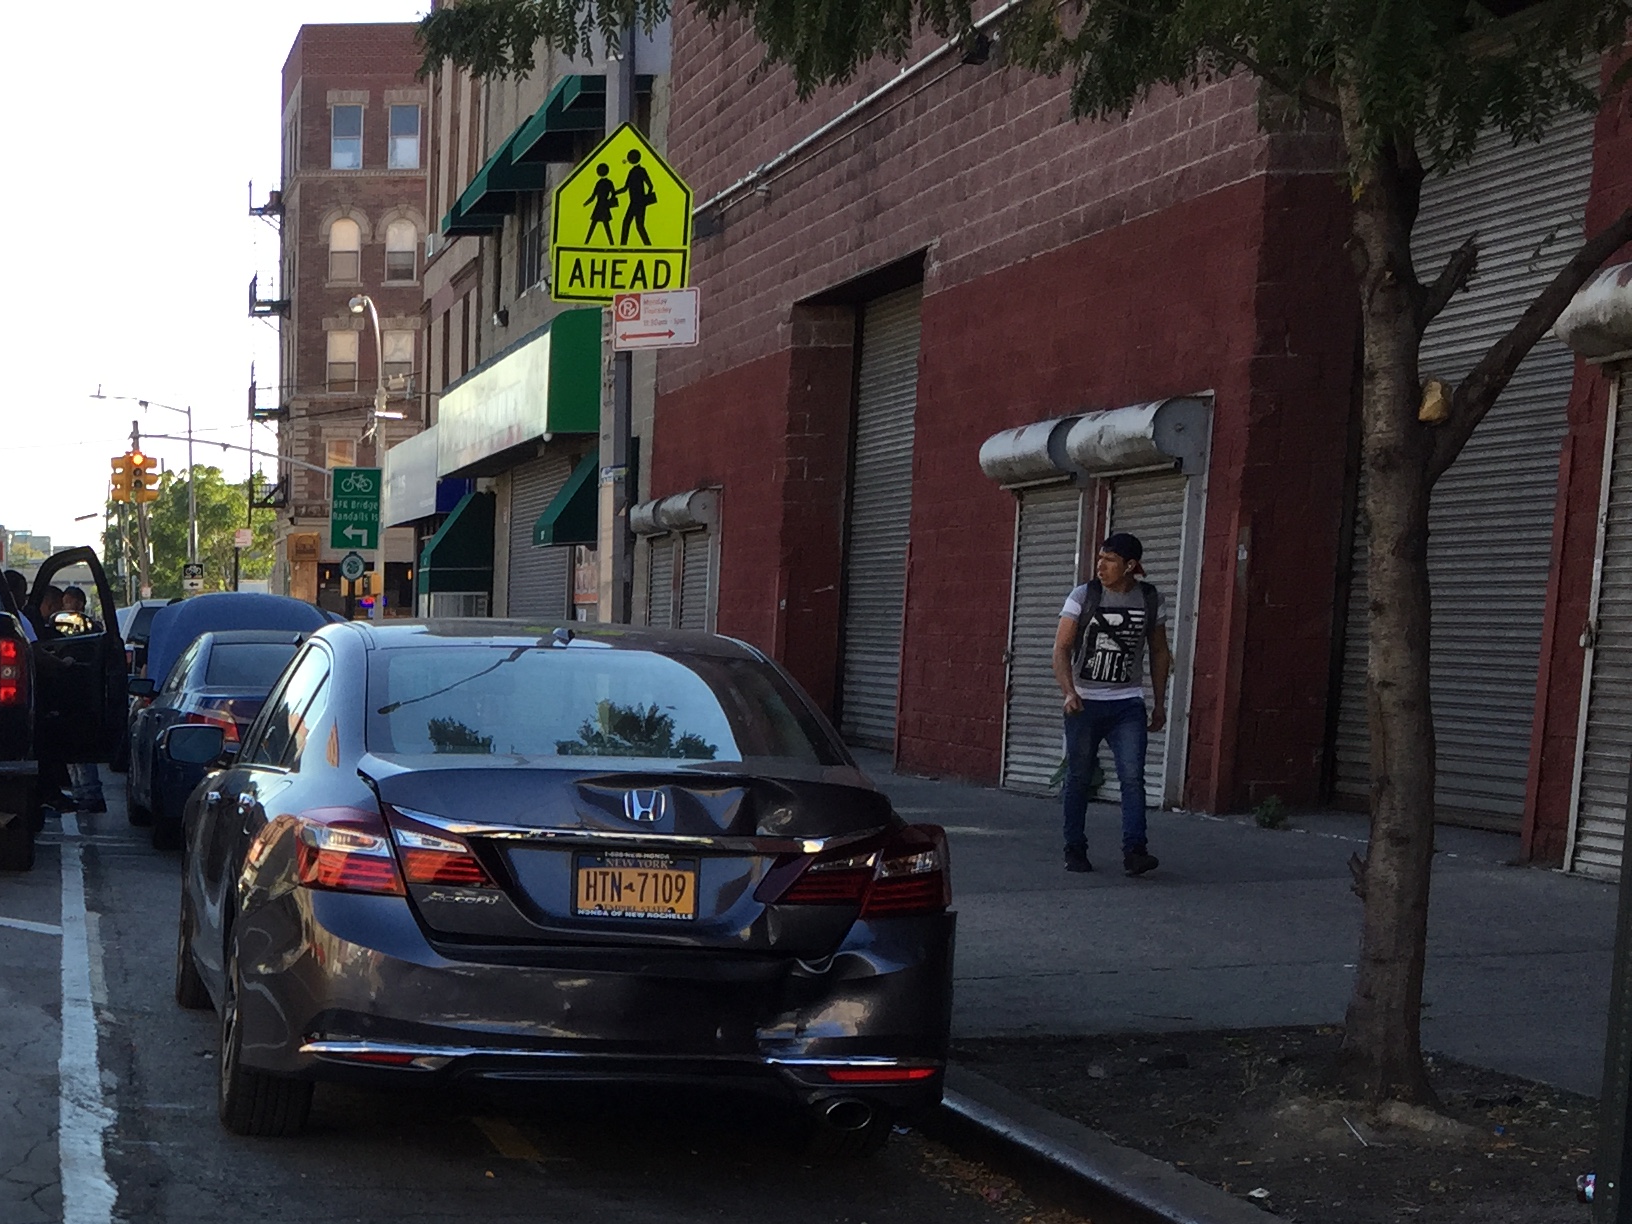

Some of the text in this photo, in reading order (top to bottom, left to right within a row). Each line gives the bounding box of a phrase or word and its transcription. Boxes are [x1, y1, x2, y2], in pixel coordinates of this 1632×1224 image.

[568, 257, 672, 290] AHEAD
[605, 858, 668, 869] NEW YORK
[577, 908, 694, 920] HONDA OF NEW ROCHELLE
